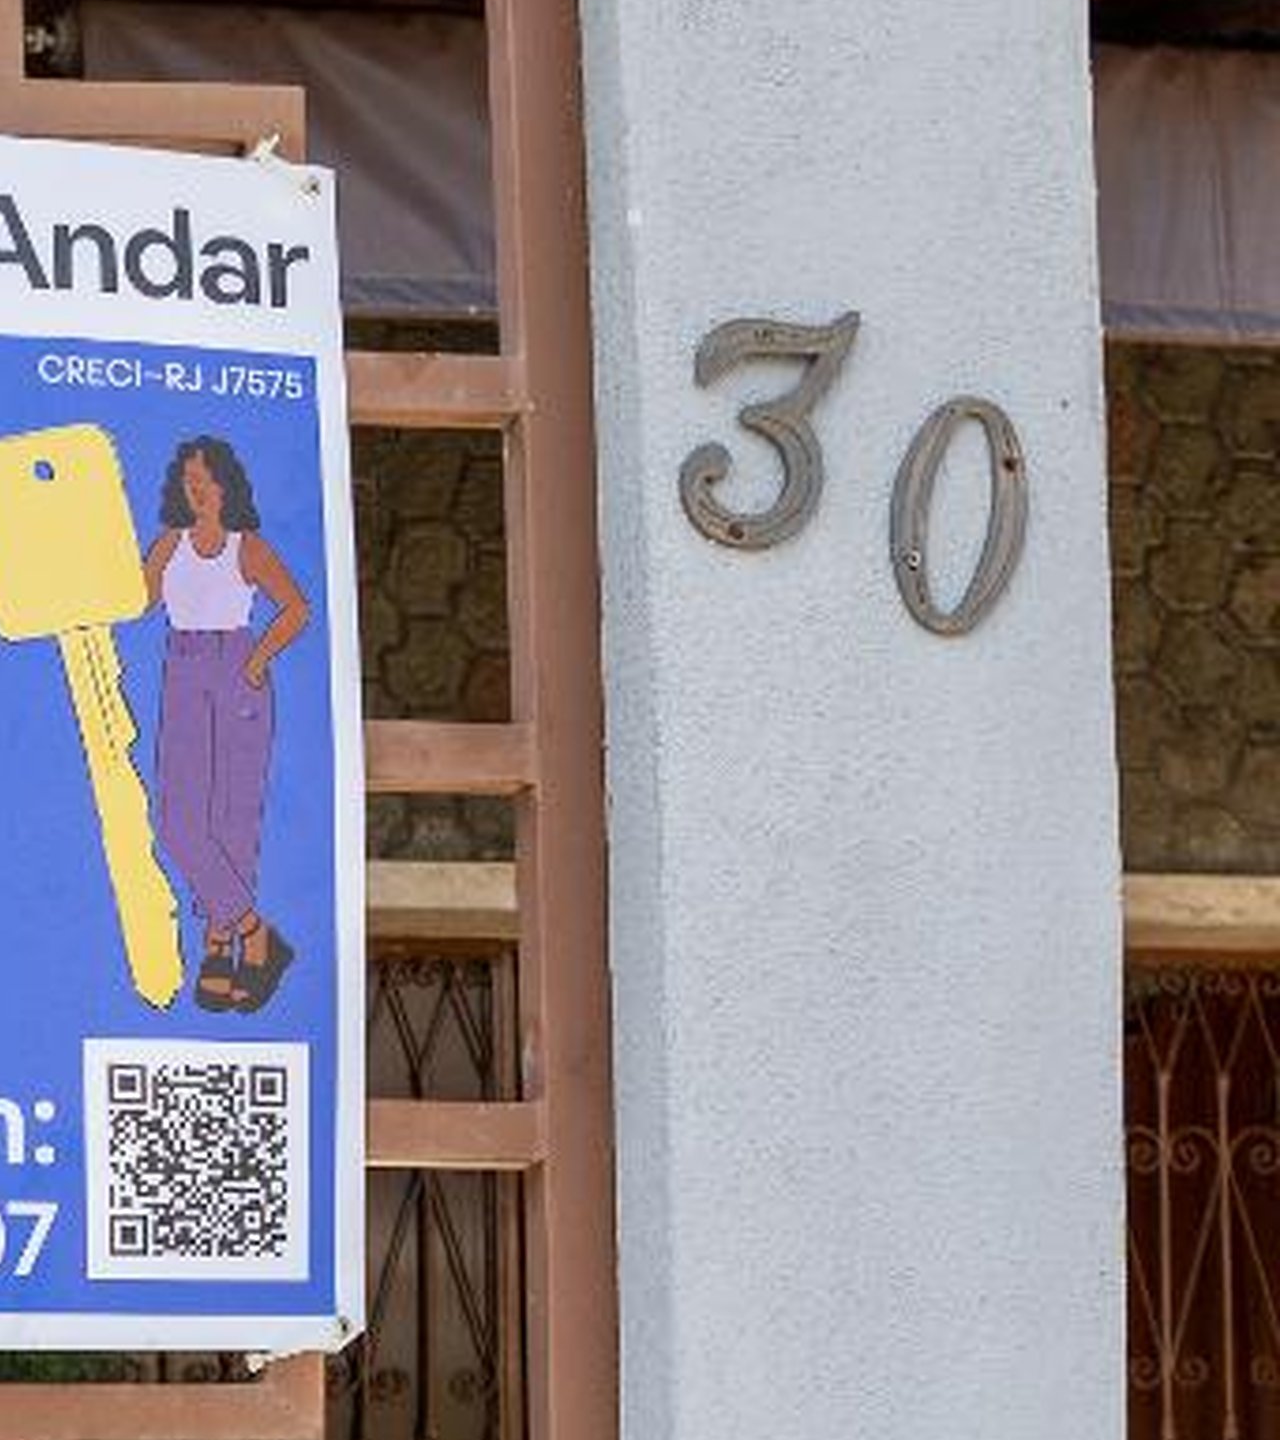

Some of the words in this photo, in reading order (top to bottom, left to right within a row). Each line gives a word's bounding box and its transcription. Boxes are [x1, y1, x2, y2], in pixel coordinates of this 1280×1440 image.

[38, 355, 202, 392] CRECI-RJ
[211, 366, 303, 398] J7575
[679, 311, 1028, 637] 30
